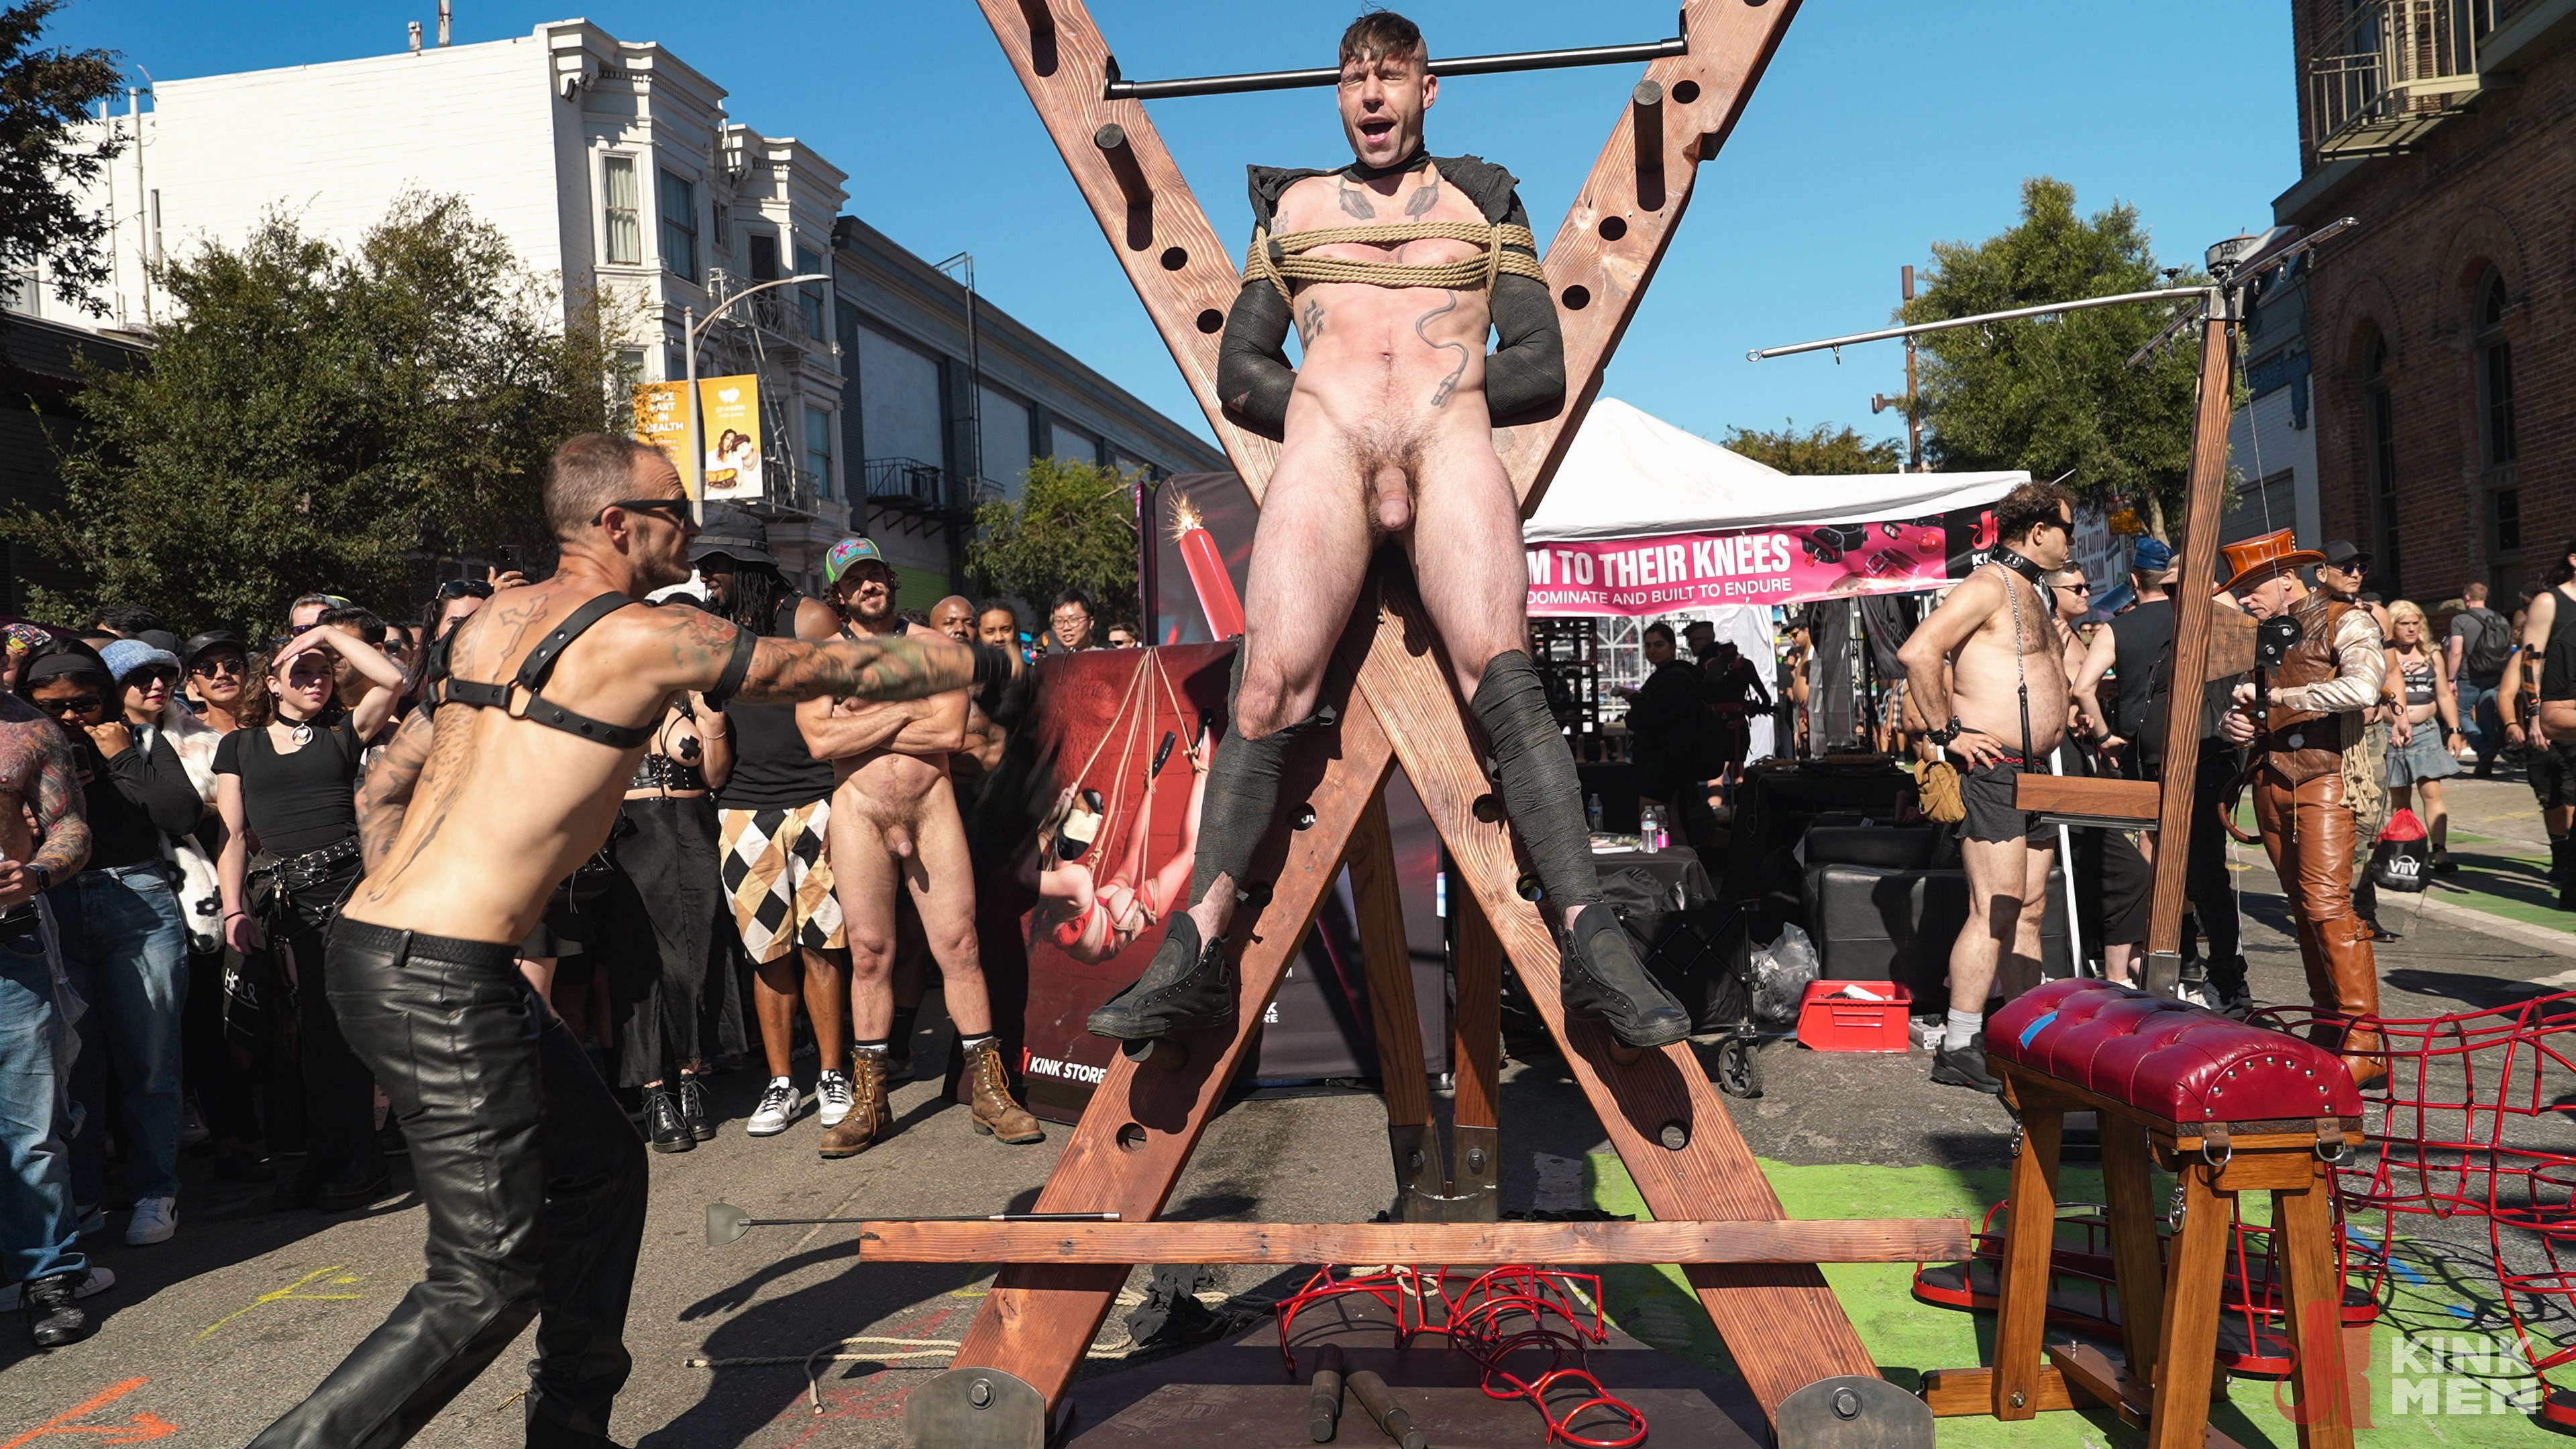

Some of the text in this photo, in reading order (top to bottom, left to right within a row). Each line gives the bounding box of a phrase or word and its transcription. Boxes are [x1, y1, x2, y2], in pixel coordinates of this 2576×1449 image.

[658, 413, 669, 421] IN
[2077, 529, 2104, 559] FIX AUTO
[1556, 549, 1594, 586] TO
[1598, 543, 1687, 588] THEIR
[1692, 533, 1791, 579] KNEES
[2082, 556, 2105, 582] OLSOM
[1527, 578, 1792, 605] DOMINATE AND BUILT TO ENDURE
[1029, 1056, 1064, 1077] KINK
